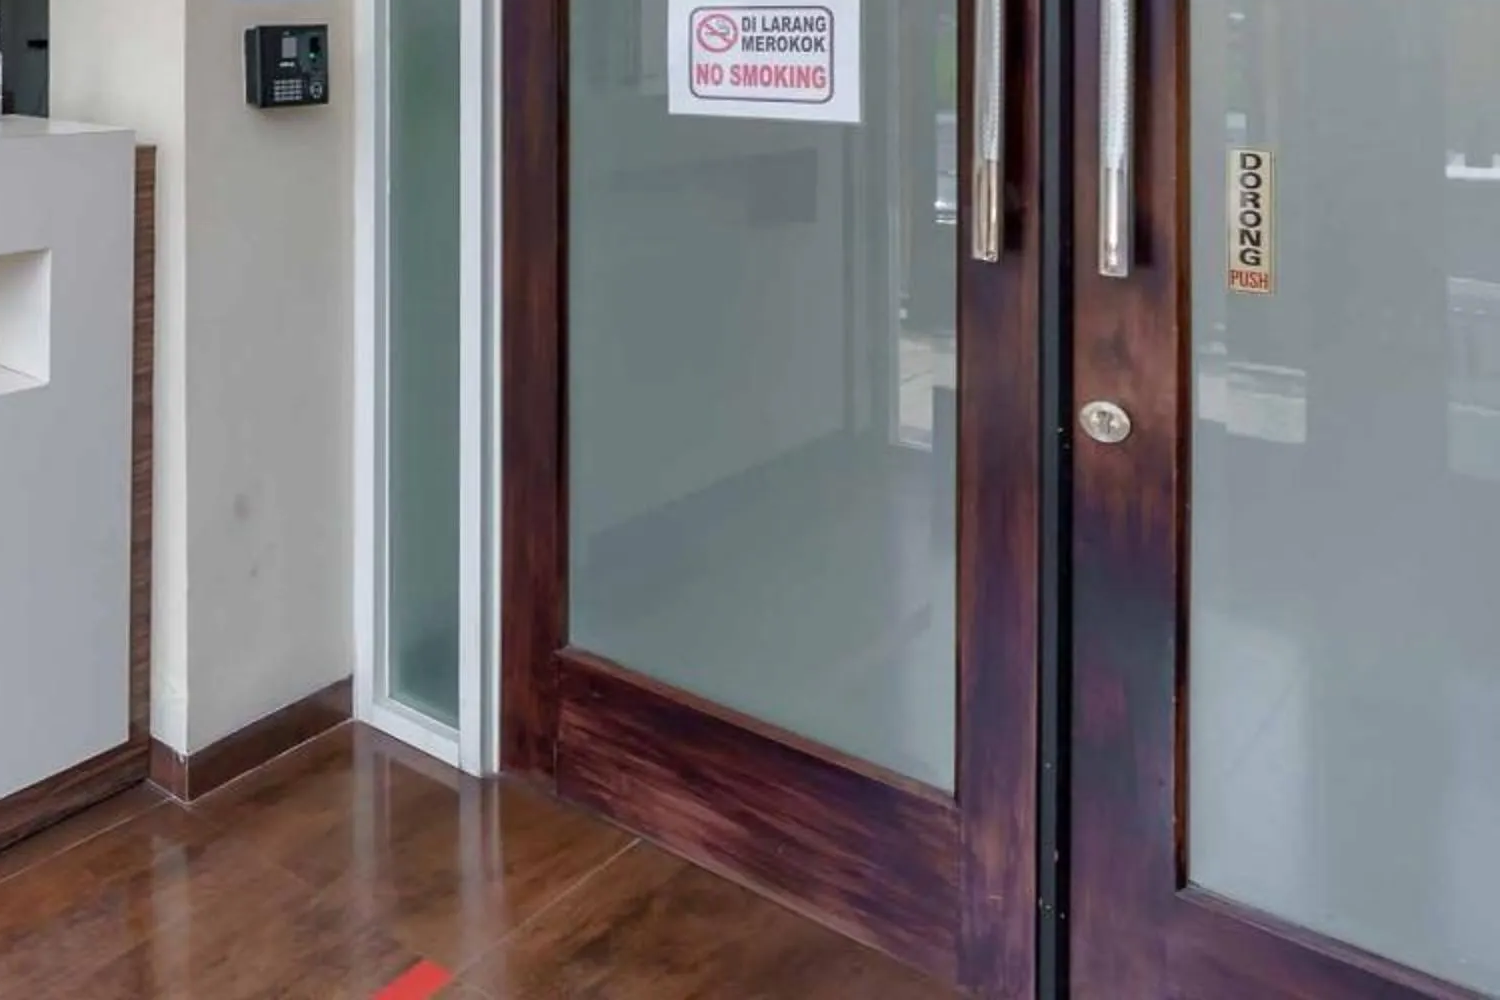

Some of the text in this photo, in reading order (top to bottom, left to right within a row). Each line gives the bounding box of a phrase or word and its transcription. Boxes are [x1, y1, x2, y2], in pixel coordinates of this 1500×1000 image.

[761, 15, 827, 33] LARANG
[741, 35, 826, 53] MEROKOK
[696, 63, 827, 89] NO SMOKING
[1239, 153, 1262, 266] DORONG
[1230, 270, 1269, 288] PUSH
